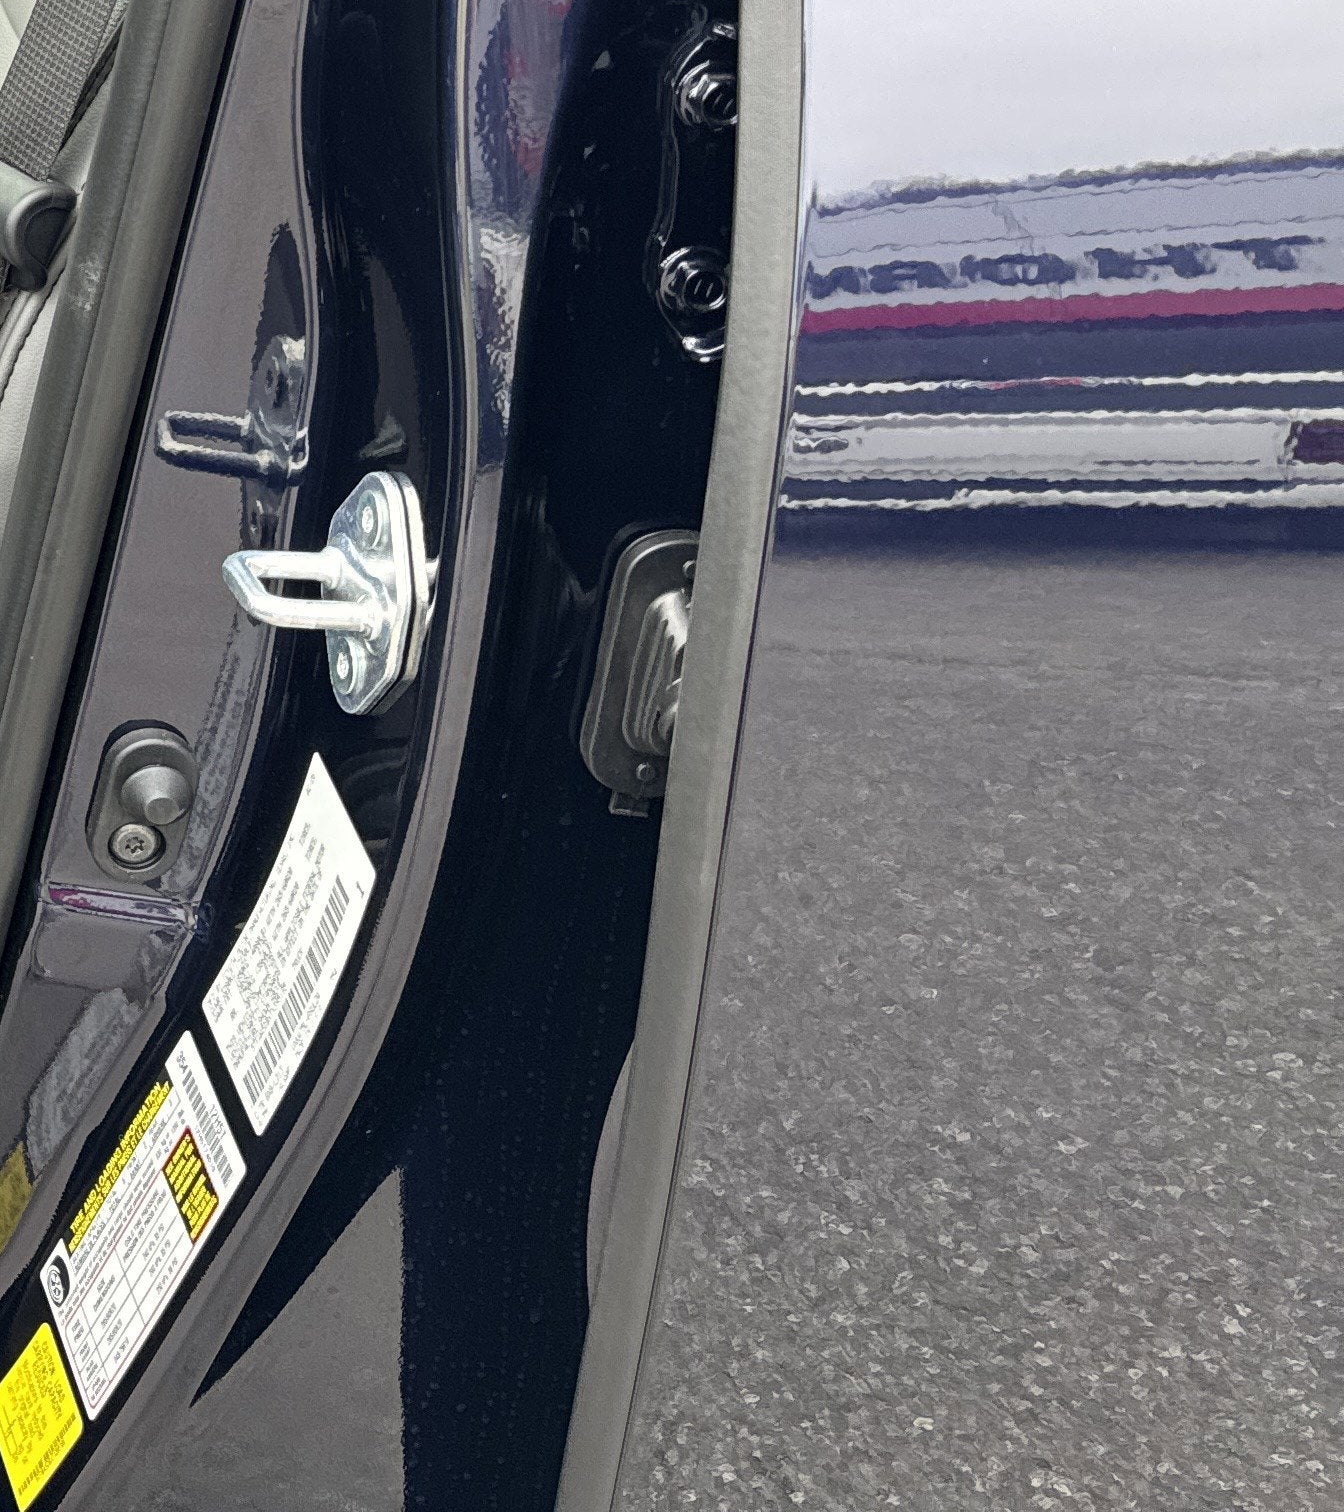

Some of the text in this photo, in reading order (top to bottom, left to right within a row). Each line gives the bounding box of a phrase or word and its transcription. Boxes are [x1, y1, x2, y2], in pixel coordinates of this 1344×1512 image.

[70, 1080, 162, 1235] TIRE AND LOADING INFORMATION
